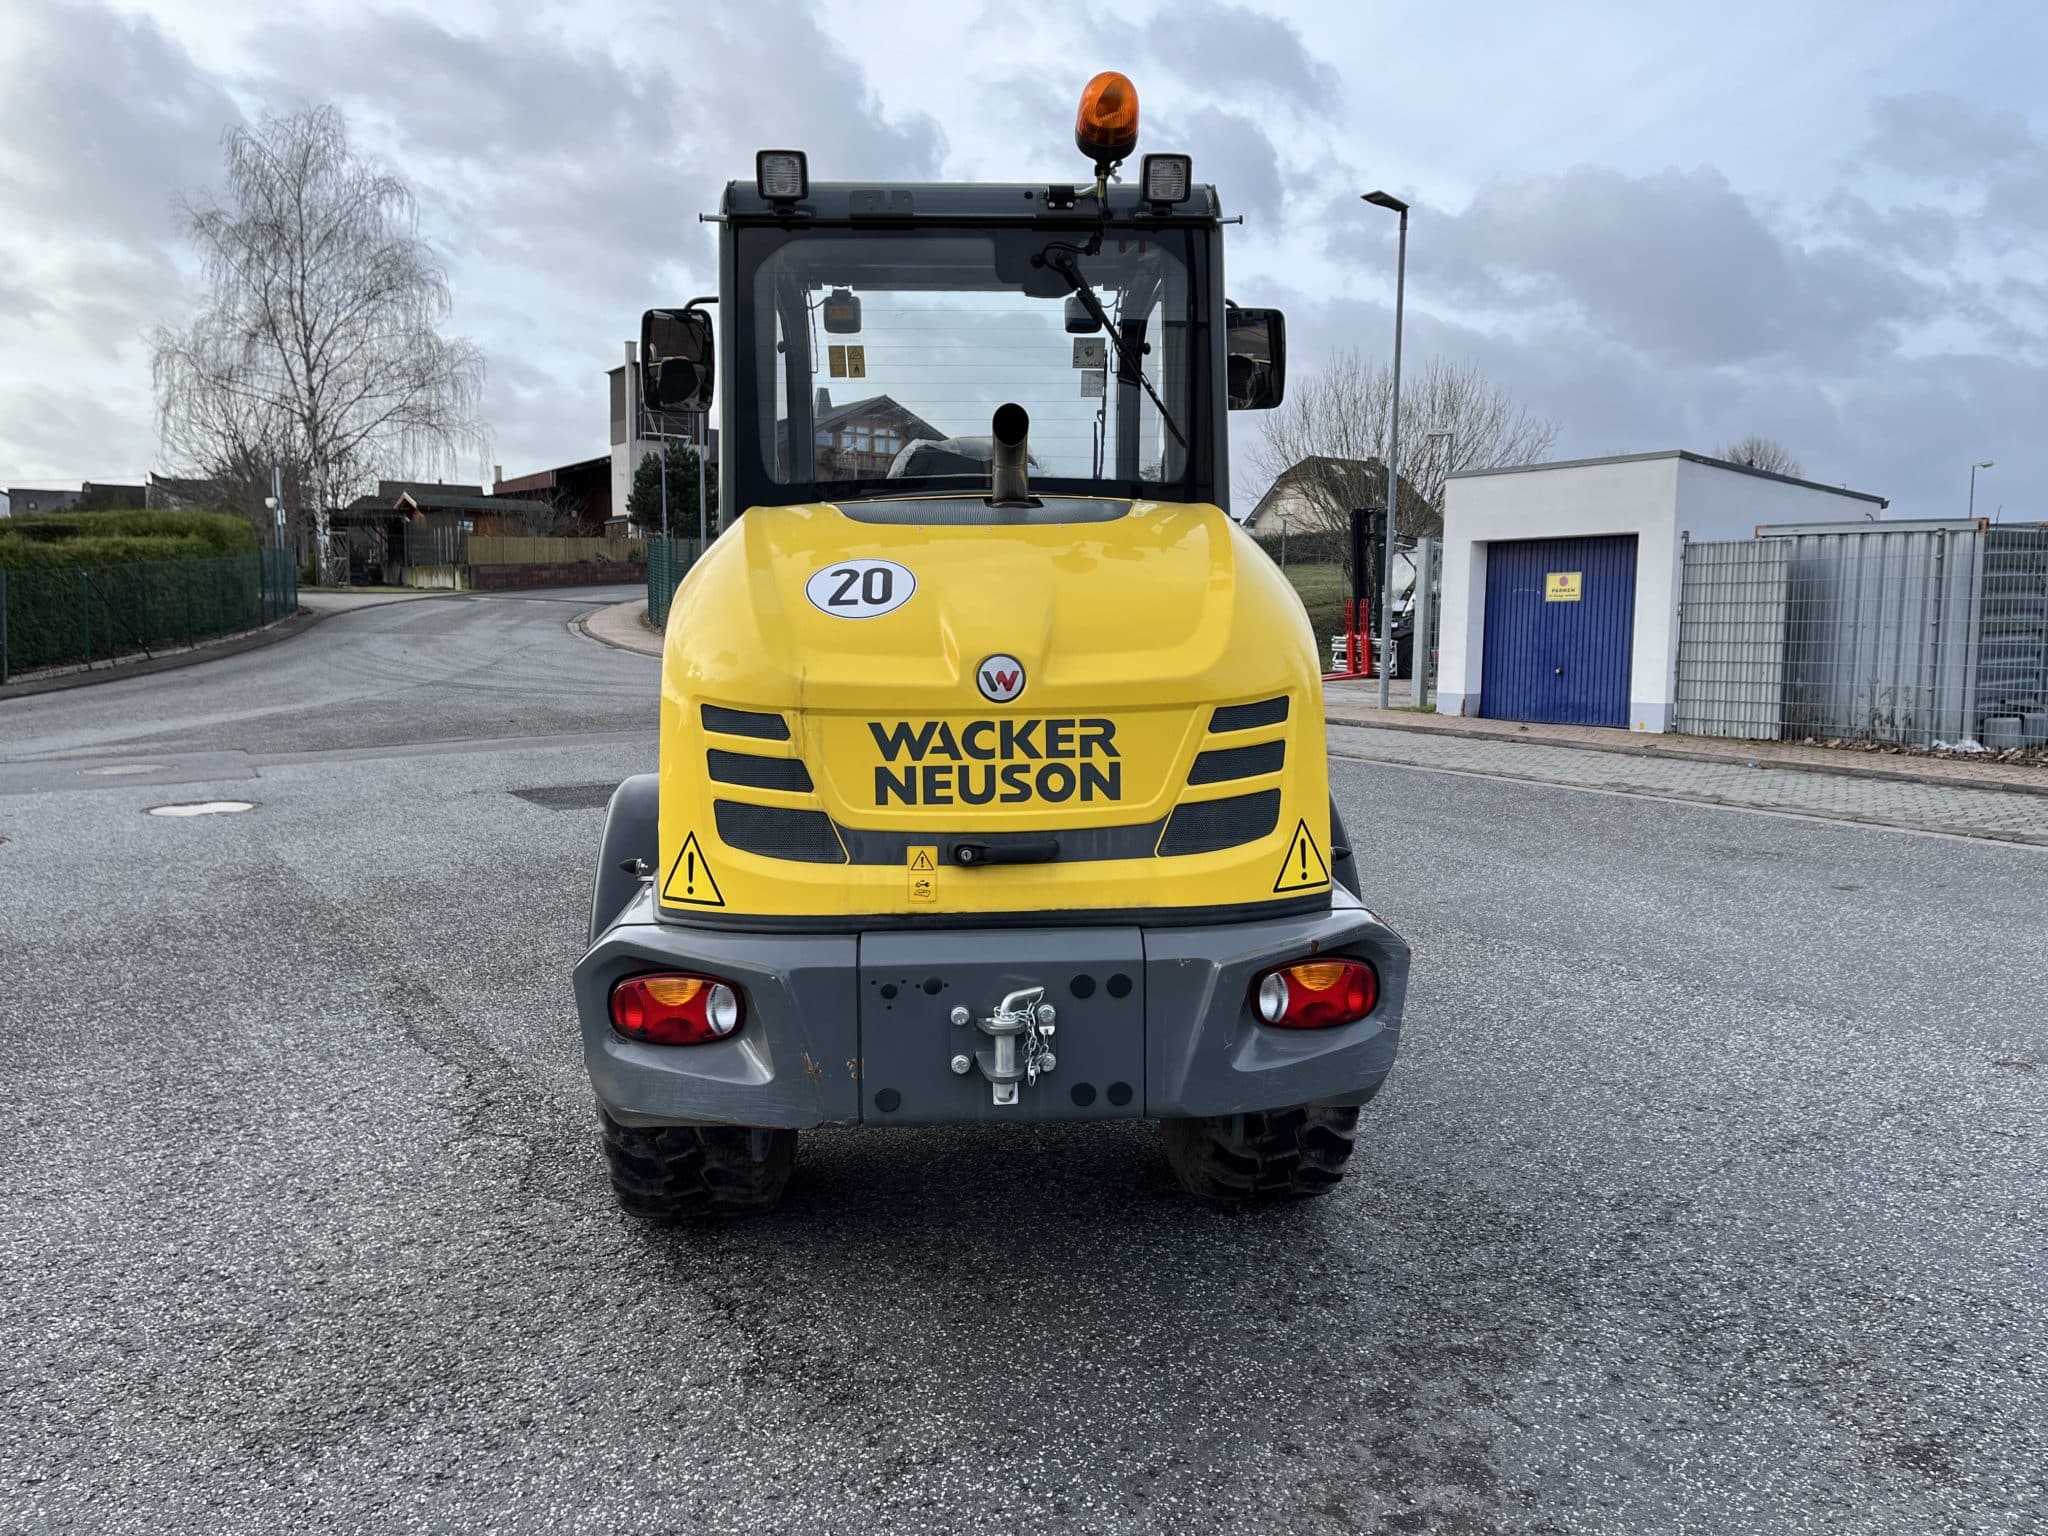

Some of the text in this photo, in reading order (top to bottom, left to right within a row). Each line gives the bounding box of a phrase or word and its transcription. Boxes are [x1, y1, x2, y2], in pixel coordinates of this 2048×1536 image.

[828, 567, 893, 606] 20
[981, 670, 1020, 692] W
[867, 719, 1121, 761] WACKER
[874, 762, 1121, 805] NEUSON
